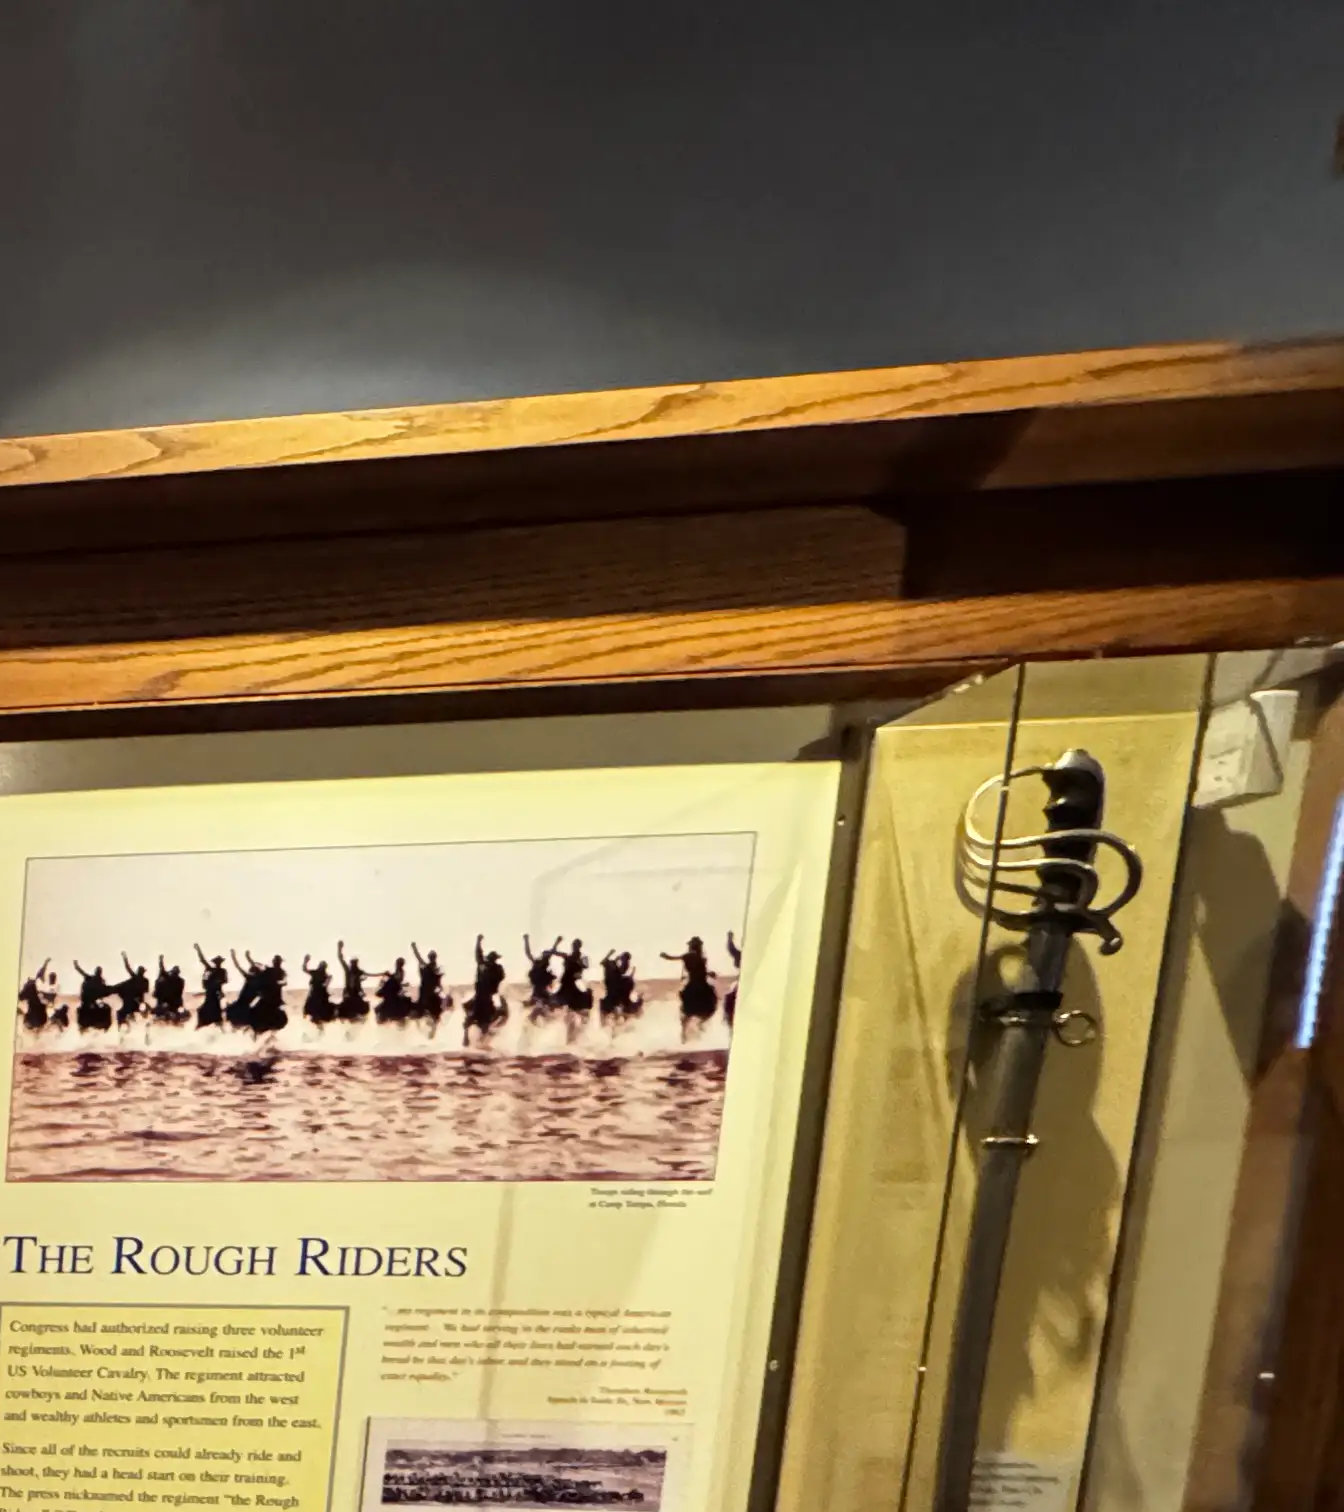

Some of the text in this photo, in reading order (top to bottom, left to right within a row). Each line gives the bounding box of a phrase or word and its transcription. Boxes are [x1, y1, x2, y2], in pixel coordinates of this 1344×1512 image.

[3, 1235, 469, 1278] THE ROUGH RIDERS
[9, 1320, 324, 1338] Congress had authorized raising three volunteer
[79, 1345, 117, 1357] Wood
[121, 1345, 144, 1357] and
[150, 1344, 215, 1358] Roosevelt
[219, 1346, 258, 1360] raised
[264, 1347, 284, 1360] the
[8, 1365, 27, 1378] US
[32, 1365, 92, 1379] Volunteer
[156, 1368, 180, 1381] The
[185, 1370, 243, 1385] regiment
[247, 1370, 305, 1383] attracted
[5, 1388, 299, 1406] cowboys and Native Americans from the west
[4, 1411, 27, 1423] and
[31, 1412, 79, 1426] wealthy
[83, 1411, 131, 1424] athletes
[135, 1413, 158, 1425] and
[163, 1414, 228, 1429] sportsmen
[232, 1414, 263, 1428] from
[268, 1416, 288, 1429] the
[2, 1442, 302, 1462] Since all of the recruits could already ride and
[42, 1466, 69, 1481] they
[74, 1466, 97, 1479] had
[101, 1470, 108, 1480] a
[113, 1467, 143, 1480] head
[147, 1469, 174, 1482] start
[179, 1472, 196, 1482] on
[200, 1470, 229, 1483] their
[0, 1486, 23, 1499] The
[27, 1489, 60, 1502] press
[64, 1488, 134, 1503] nicknamed
[138, 1490, 158, 1503] the
[162, 1492, 219, 1507] regiment
[255, 1494, 300, 1510] Rough
